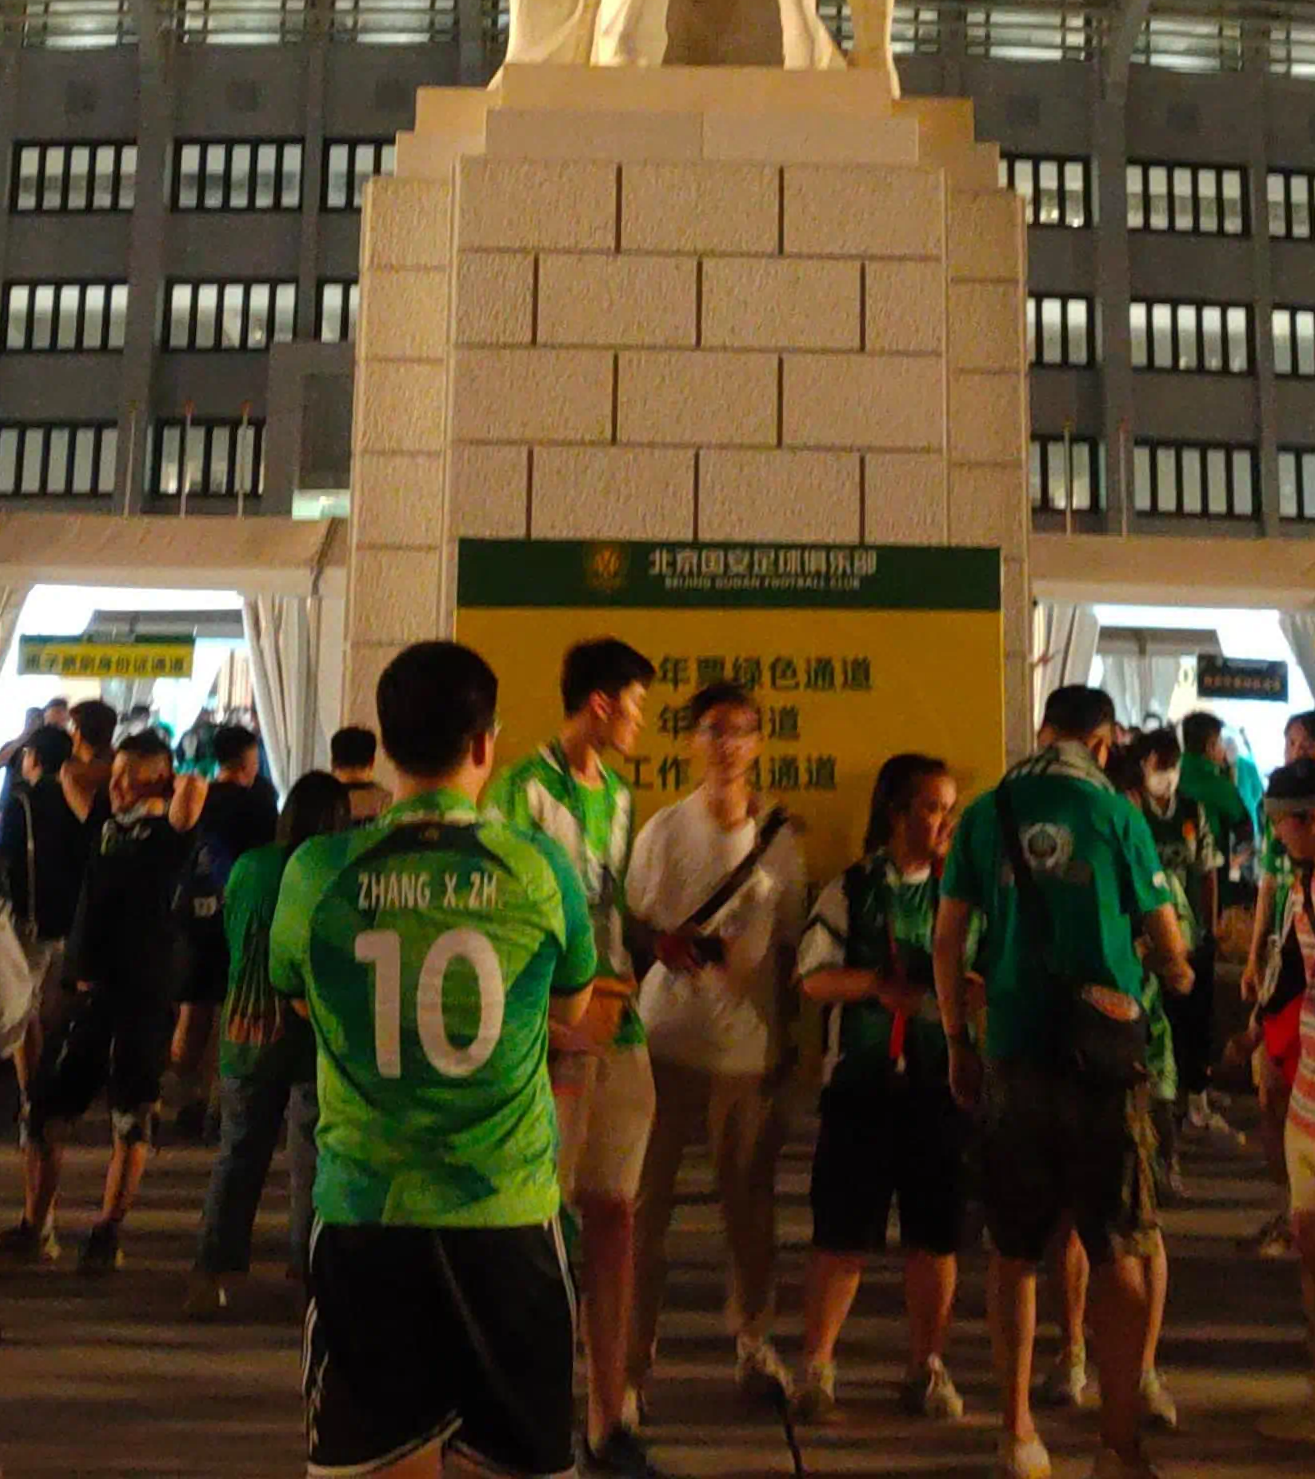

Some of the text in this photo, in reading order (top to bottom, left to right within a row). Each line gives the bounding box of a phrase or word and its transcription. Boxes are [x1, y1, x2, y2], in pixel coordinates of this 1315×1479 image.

[649, 549, 877, 575] 北京国安足球俱乐部
[659, 706, 800, 740] 年道
[625, 756, 837, 790] 工作通道
[358, 871, 431, 910] ZHANG
[355, 929, 505, 1078] 10
